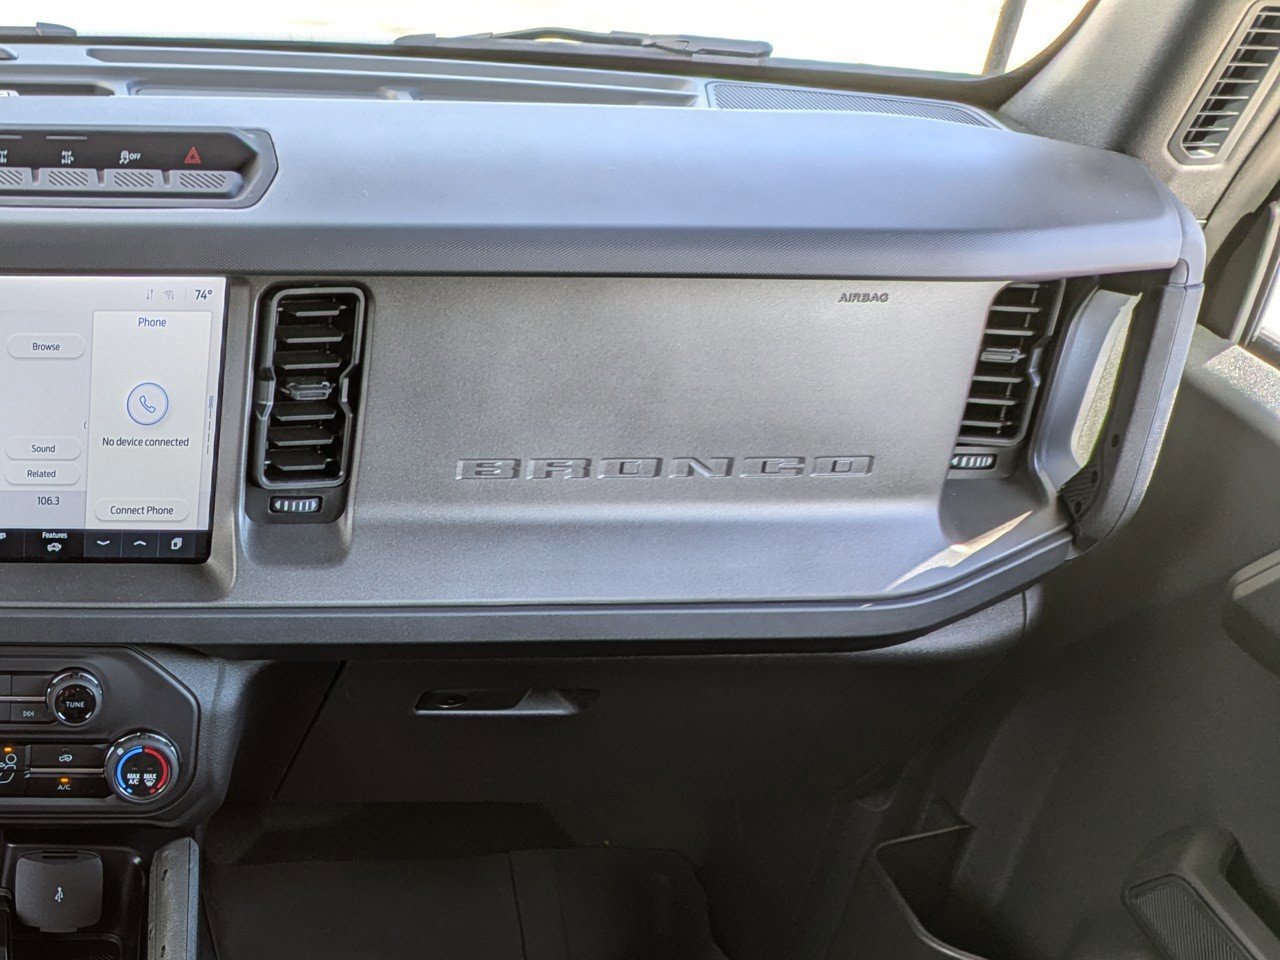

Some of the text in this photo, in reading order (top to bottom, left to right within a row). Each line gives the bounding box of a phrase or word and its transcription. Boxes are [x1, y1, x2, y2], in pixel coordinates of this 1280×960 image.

[129, 152, 141, 160] OFF
[838, 292, 889, 303] AIRBAG
[138, 316, 167, 328] Phone
[32, 342, 60, 352] Browse
[102, 437, 190, 447] No device connected
[31, 444, 56, 453] Sound
[455, 455, 877, 481] BRONCO
[27, 469, 56, 479] Related
[37, 496, 60, 506] 106.3
[110, 505, 174, 515] Connect Phone
[42, 531, 68, 539] Features
